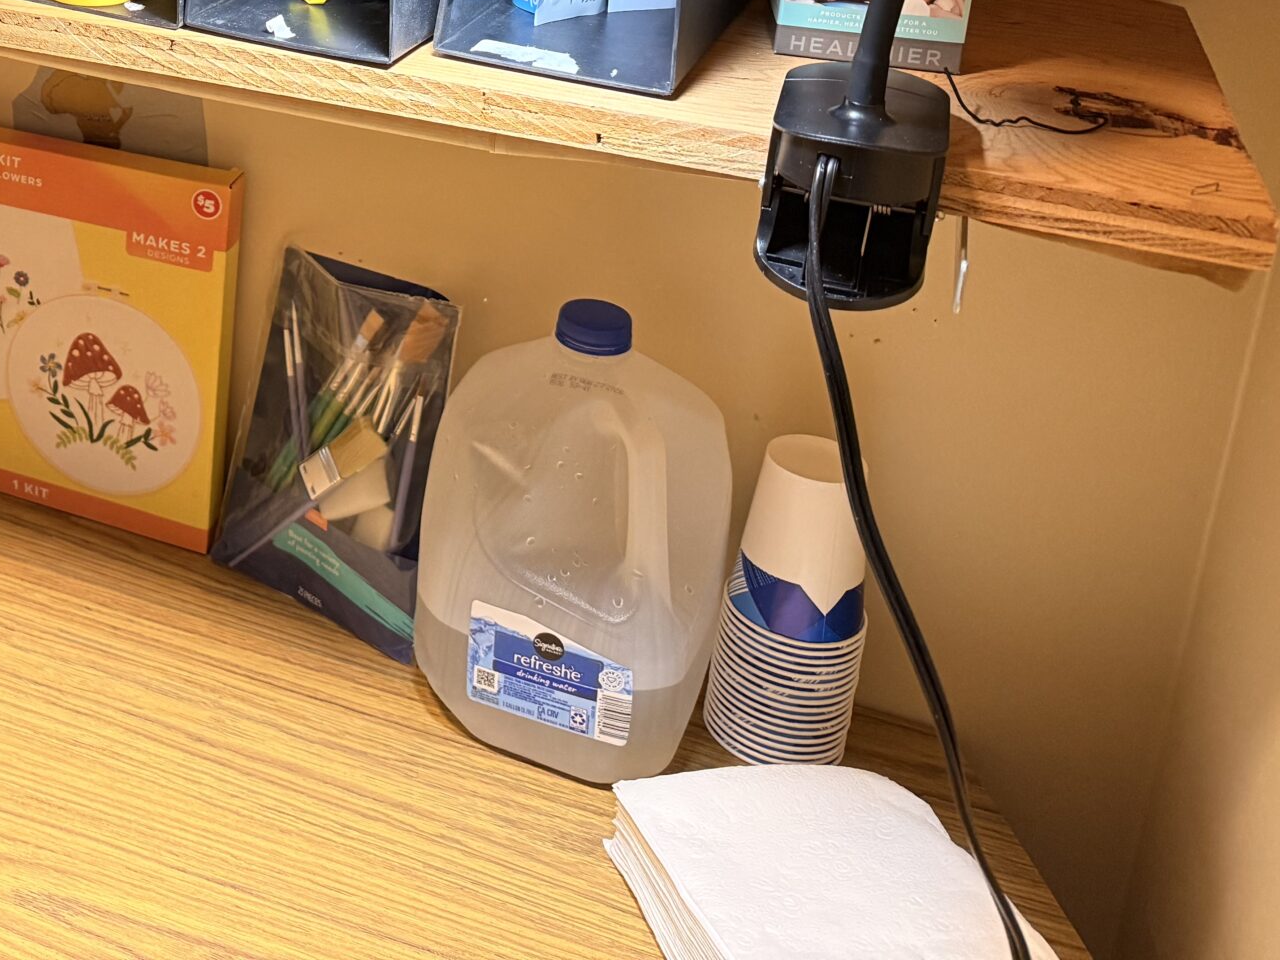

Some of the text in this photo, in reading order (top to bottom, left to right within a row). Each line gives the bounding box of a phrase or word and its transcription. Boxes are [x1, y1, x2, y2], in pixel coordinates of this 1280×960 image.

[807, 17, 843, 27] HAPPIER,
[921, 29, 938, 37] YOU
[820, 10, 862, 21] PRODUCTS
[903, 19, 919, 27] FOR
[789, 35, 942, 67] HEALIER
[196, 194, 215, 214] $5
[131, 231, 206, 258] MAKES 2
[147, 248, 190, 265] DESIGNS
[12, 479, 49, 499] 1 KIT
[516, 670, 578, 693] drinking water
